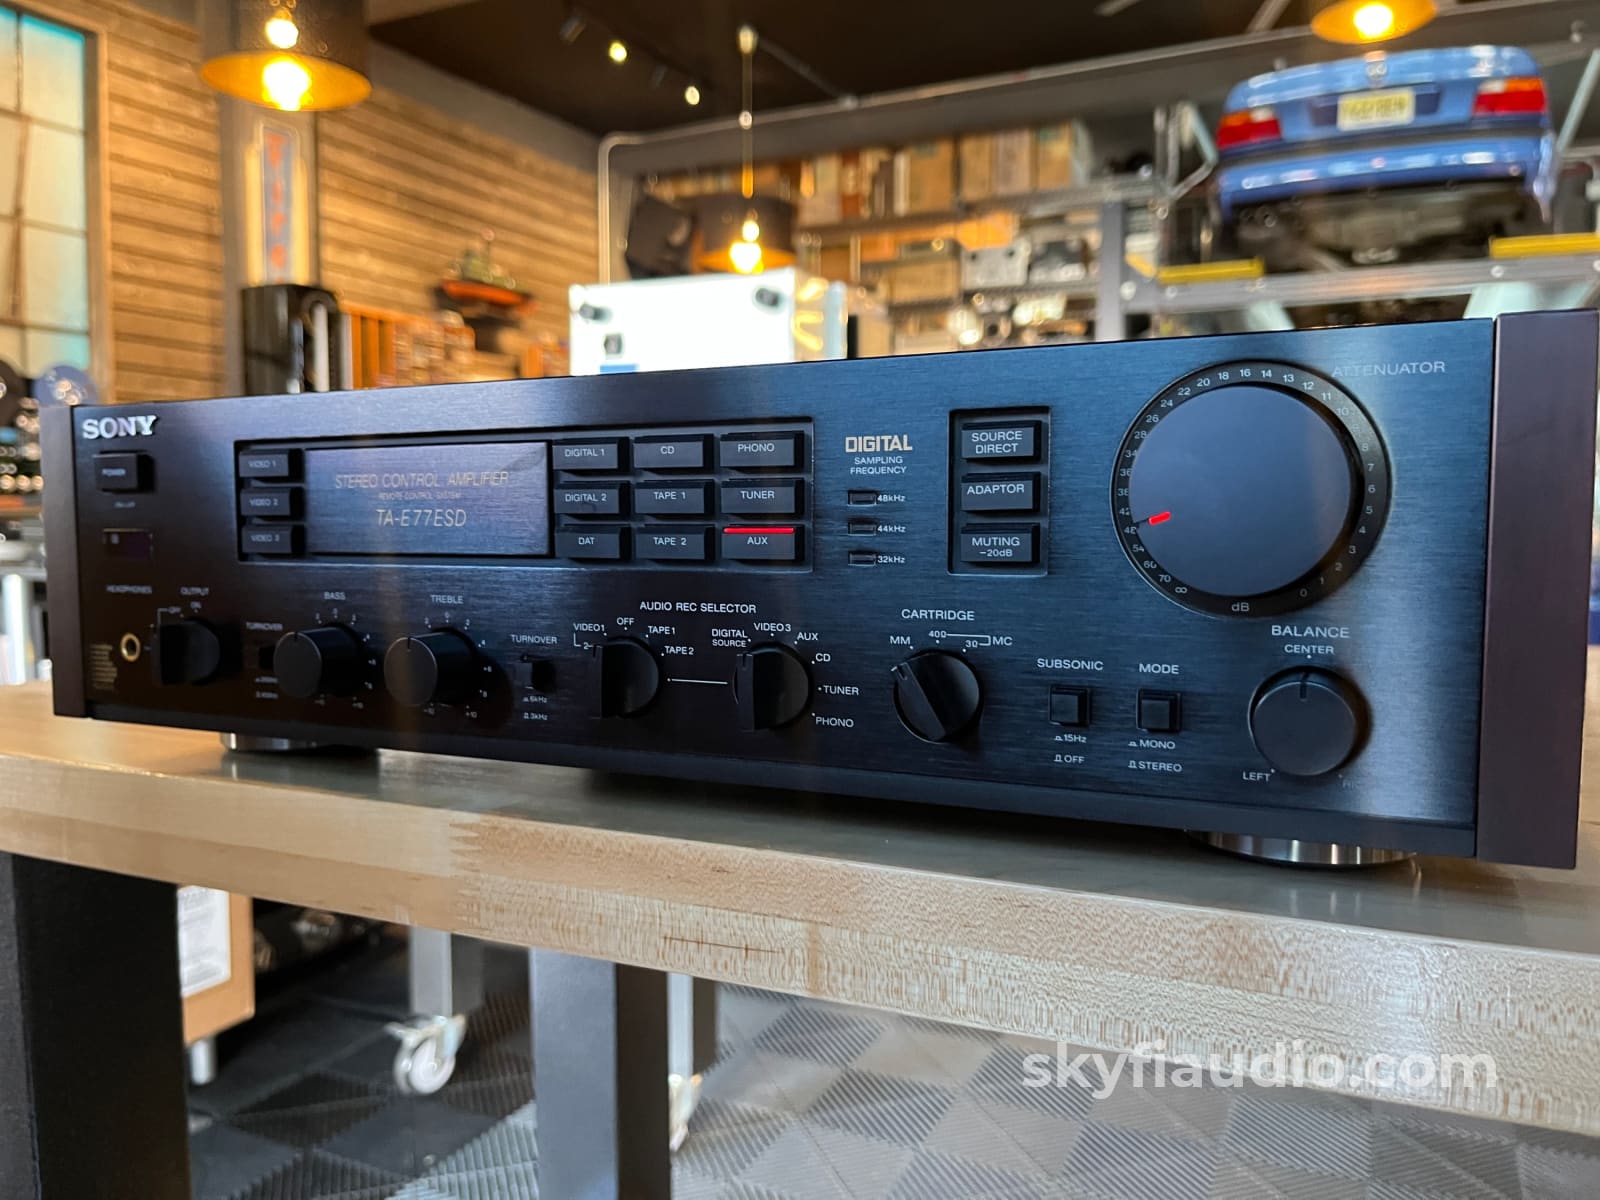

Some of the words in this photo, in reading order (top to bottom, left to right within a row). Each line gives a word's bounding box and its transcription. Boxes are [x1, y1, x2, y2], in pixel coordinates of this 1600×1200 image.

[1240, 369, 1251, 377] 16
[1261, 370, 1272, 378] 14
[1331, 361, 1446, 378] ATTENUATOR
[1218, 372, 1229, 380] 18
[1283, 374, 1294, 383] 13
[1197, 378, 1210, 387] 20
[1302, 382, 1314, 390] 12
[1178, 388, 1191, 396] 22
[1321, 392, 1331, 400] 11
[1146, 415, 1159, 423] 26
[82, 415, 157, 439] SONY
[971, 431, 1023, 442] SOURCE
[737, 443, 775, 452] PHONO
[845, 434, 913, 452] DIGITAL
[564, 448, 599, 457] DIGITAL
[660, 446, 675, 454] CD
[975, 443, 1018, 454] DIRECT
[854, 456, 903, 465] SAMPLING
[850, 466, 907, 474] FREQUENCY
[1367, 463, 1375, 472] 7
[335, 474, 378, 489] STEREO
[382, 473, 440, 488] CONTROL
[447, 471, 509, 486] AMPLIFIER
[966, 483, 1025, 495] ADAPTOR
[1368, 484, 1376, 493] 6
[564, 493, 598, 502] DIGITAL
[601, 493, 607, 501] 2
[653, 491, 677, 500] TAPE
[740, 490, 775, 499] TUNER
[877, 494, 906, 502] 48kHz
[1365, 505, 1373, 514] 5
[375, 508, 467, 527] TA-E77ESD
[877, 524, 906, 533] 44kHz
[1358, 526, 1366, 534] 4
[578, 537, 595, 545] DAT
[653, 537, 677, 546] TAPE
[680, 537, 687, 546] 2
[747, 536, 768, 545] AUX
[971, 536, 1021, 547] MUTING
[1349, 545, 1357, 554] 3
[877, 555, 906, 564] 32kHz
[1334, 562, 1343, 571] 2
[1159, 574, 1171, 583] 70
[324, 591, 346, 600] BASS
[1299, 588, 1308, 597] 0
[430, 594, 463, 604] TREBLE
[639, 601, 672, 611] AUDIO
[675, 602, 697, 612] REC
[700, 603, 757, 613] SELECTOR
[1231, 602, 1250, 612] dB
[901, 609, 975, 621] CARTRIDGE
[616, 617, 635, 626] OFF
[711, 628, 748, 638] DIGITAL
[1271, 624, 1351, 638] BALANCE
[511, 634, 558, 644] TURNOVER
[797, 632, 819, 641] AUX
[890, 635, 911, 645] MM
[992, 636, 1013, 646] MC
[712, 639, 747, 648] SOURCE
[1284, 644, 1335, 655] CENTER
[815, 653, 831, 662] CD
[1037, 658, 1104, 671] SUBSONIC
[1138, 663, 1180, 674] MODE
[824, 684, 859, 696] TUNER
[815, 716, 854, 728] PHONO
[1063, 734, 1087, 743] 15Hz
[1139, 739, 1176, 750] MONO
[1064, 754, 1085, 764] OFF
[1138, 761, 1183, 772] STEREO
[1243, 771, 1271, 782] LEFT
